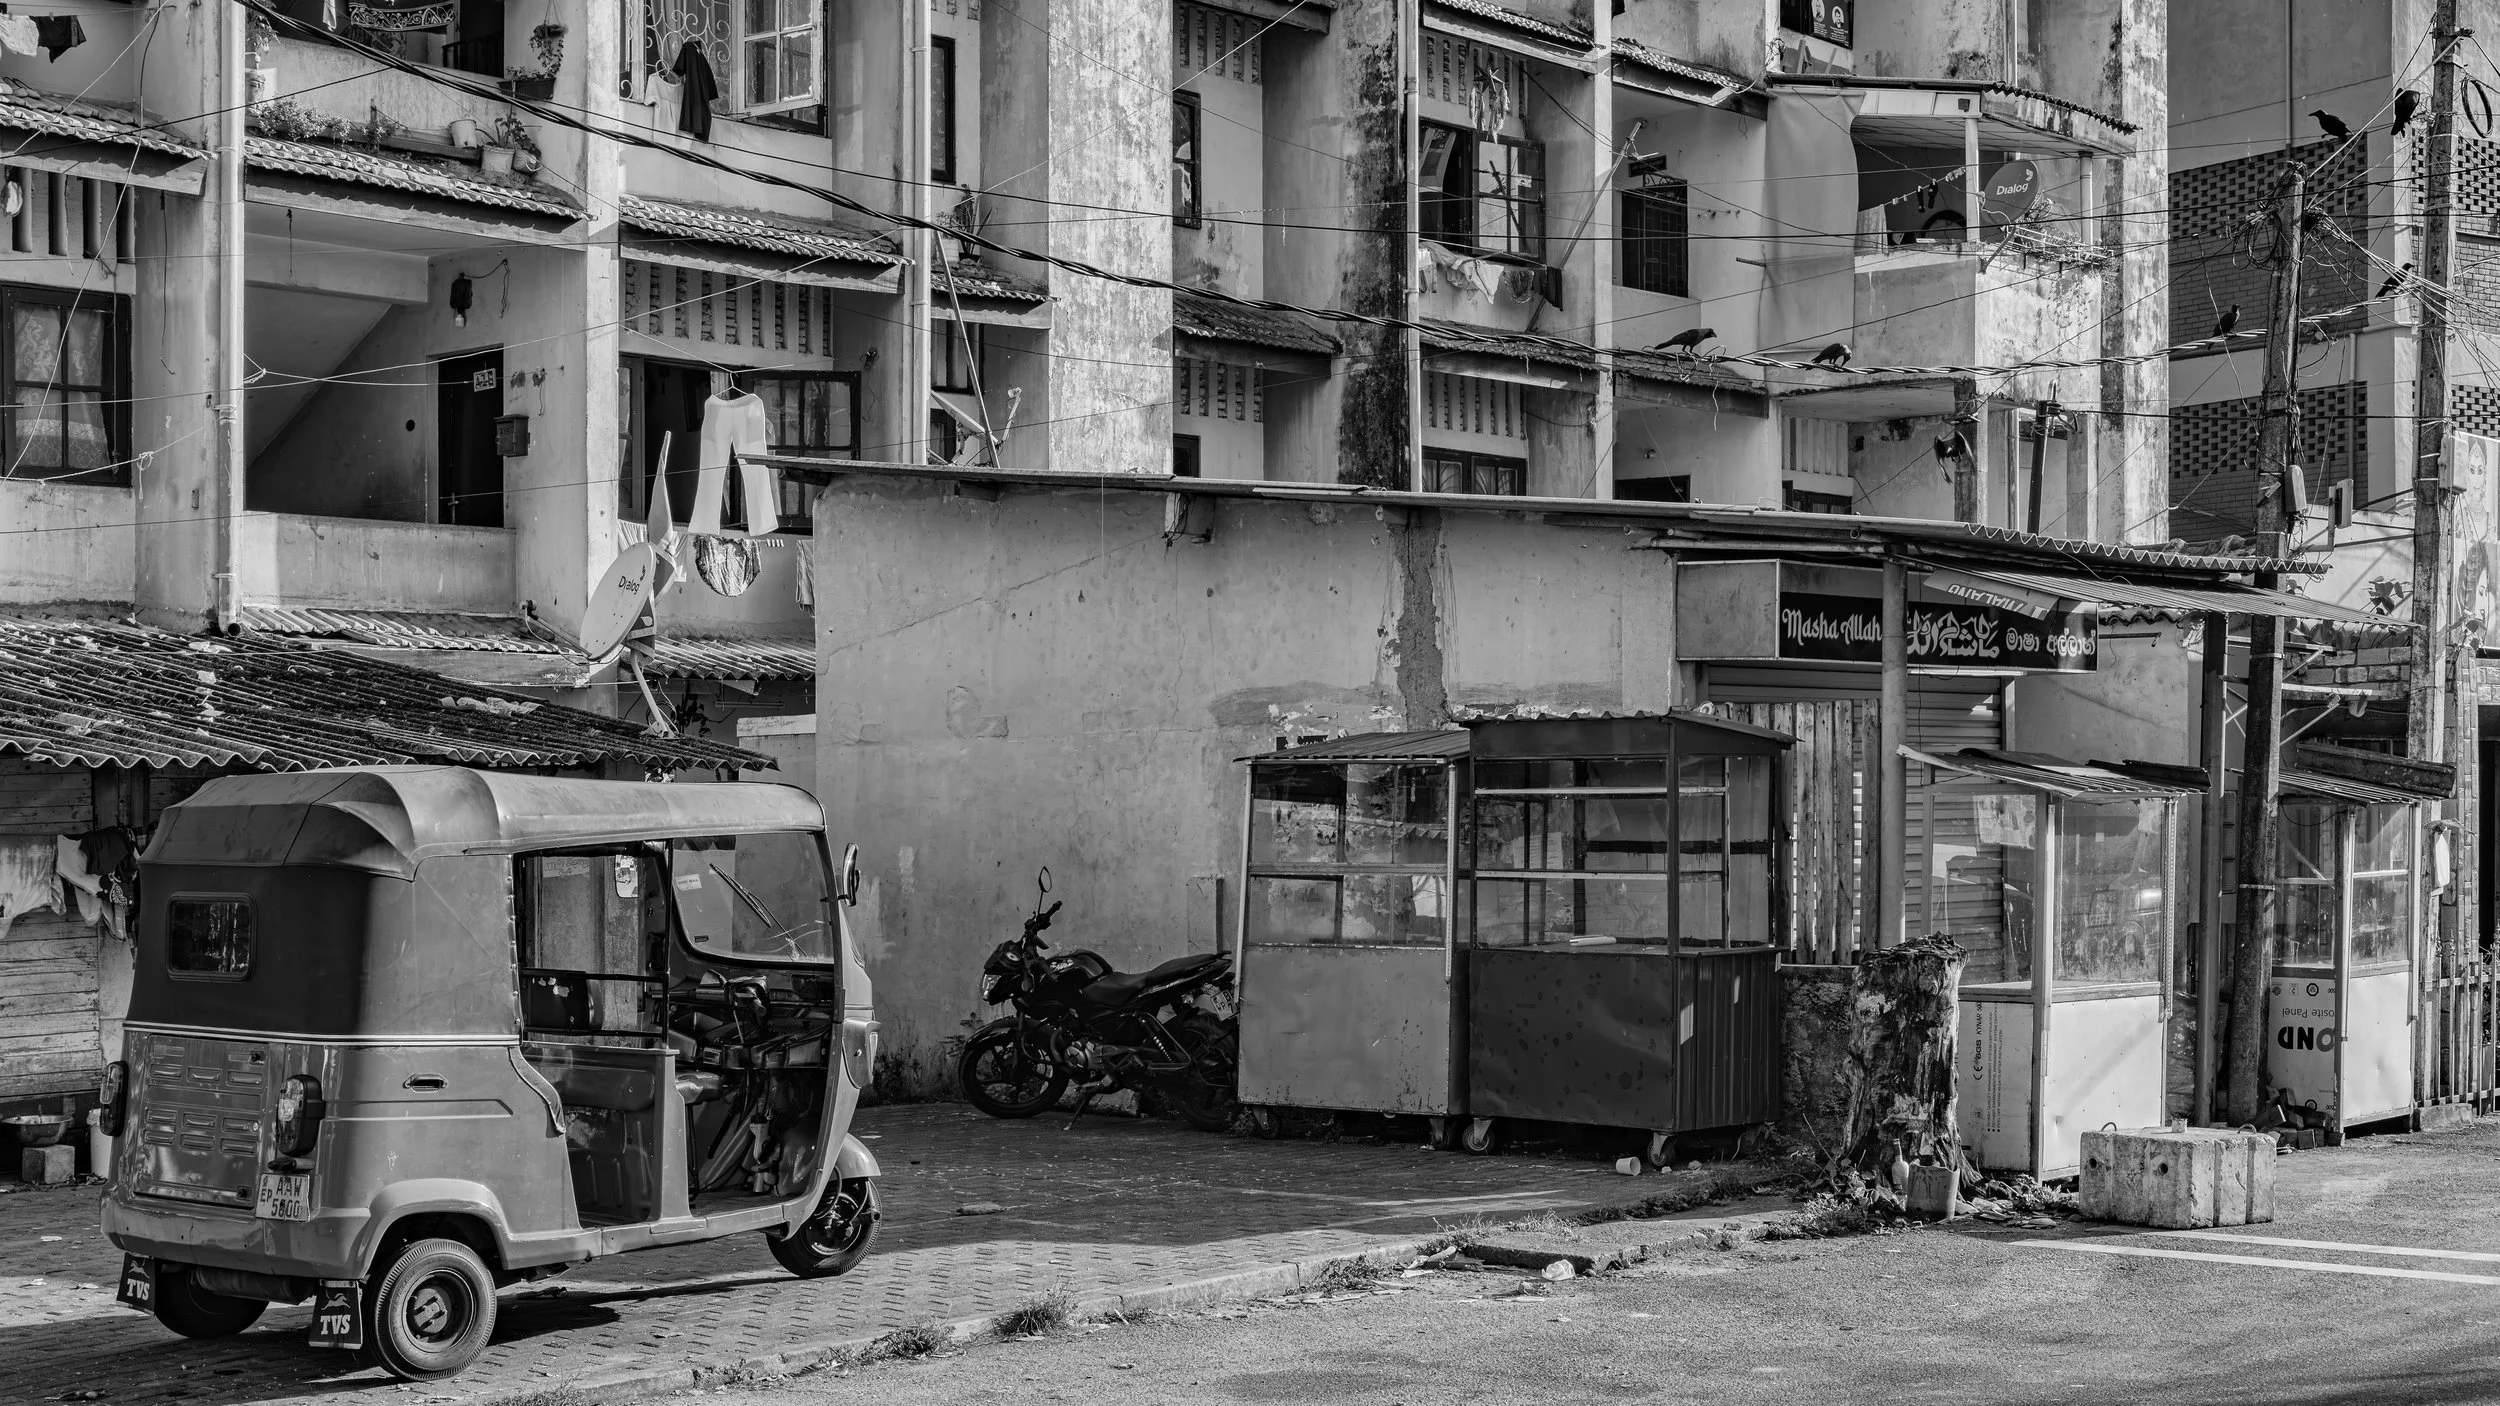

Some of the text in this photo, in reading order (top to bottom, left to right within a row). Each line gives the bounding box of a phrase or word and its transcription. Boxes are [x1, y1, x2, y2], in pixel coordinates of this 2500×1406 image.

[1996, 183, 2029, 195] Dialog
[1782, 608, 1882, 646] Masha Allah
[2282, 1007, 2308, 1018] Panel
[260, 1188, 273, 1202] EP
[276, 1177, 302, 1197] AAW
[126, 1279, 150, 1300] TVS
[320, 1315, 350, 1335] TVS
